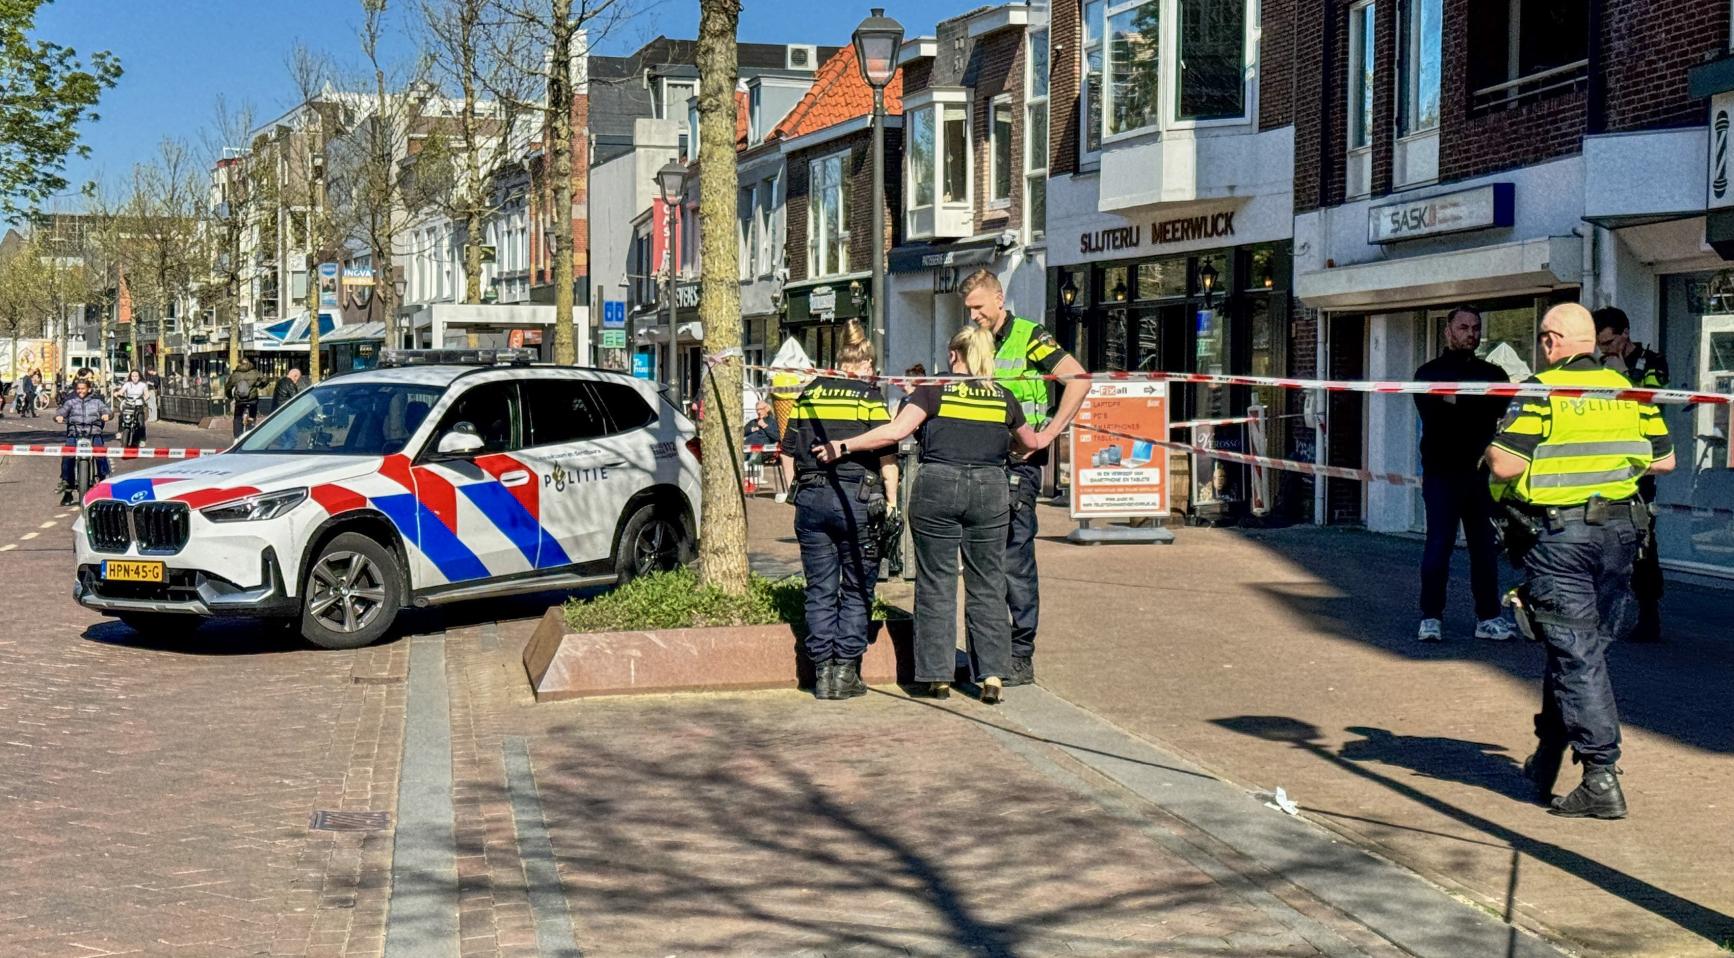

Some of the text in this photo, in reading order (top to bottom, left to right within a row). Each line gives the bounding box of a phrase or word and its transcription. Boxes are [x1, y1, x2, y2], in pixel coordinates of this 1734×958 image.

[1080, 211, 1235, 253] SLIJTERIJ MEERWIJCK
[1560, 398, 1632, 416] POLITIE
[545, 463, 609, 492] POLITIE
[109, 562, 160, 580] HPN-45-G
